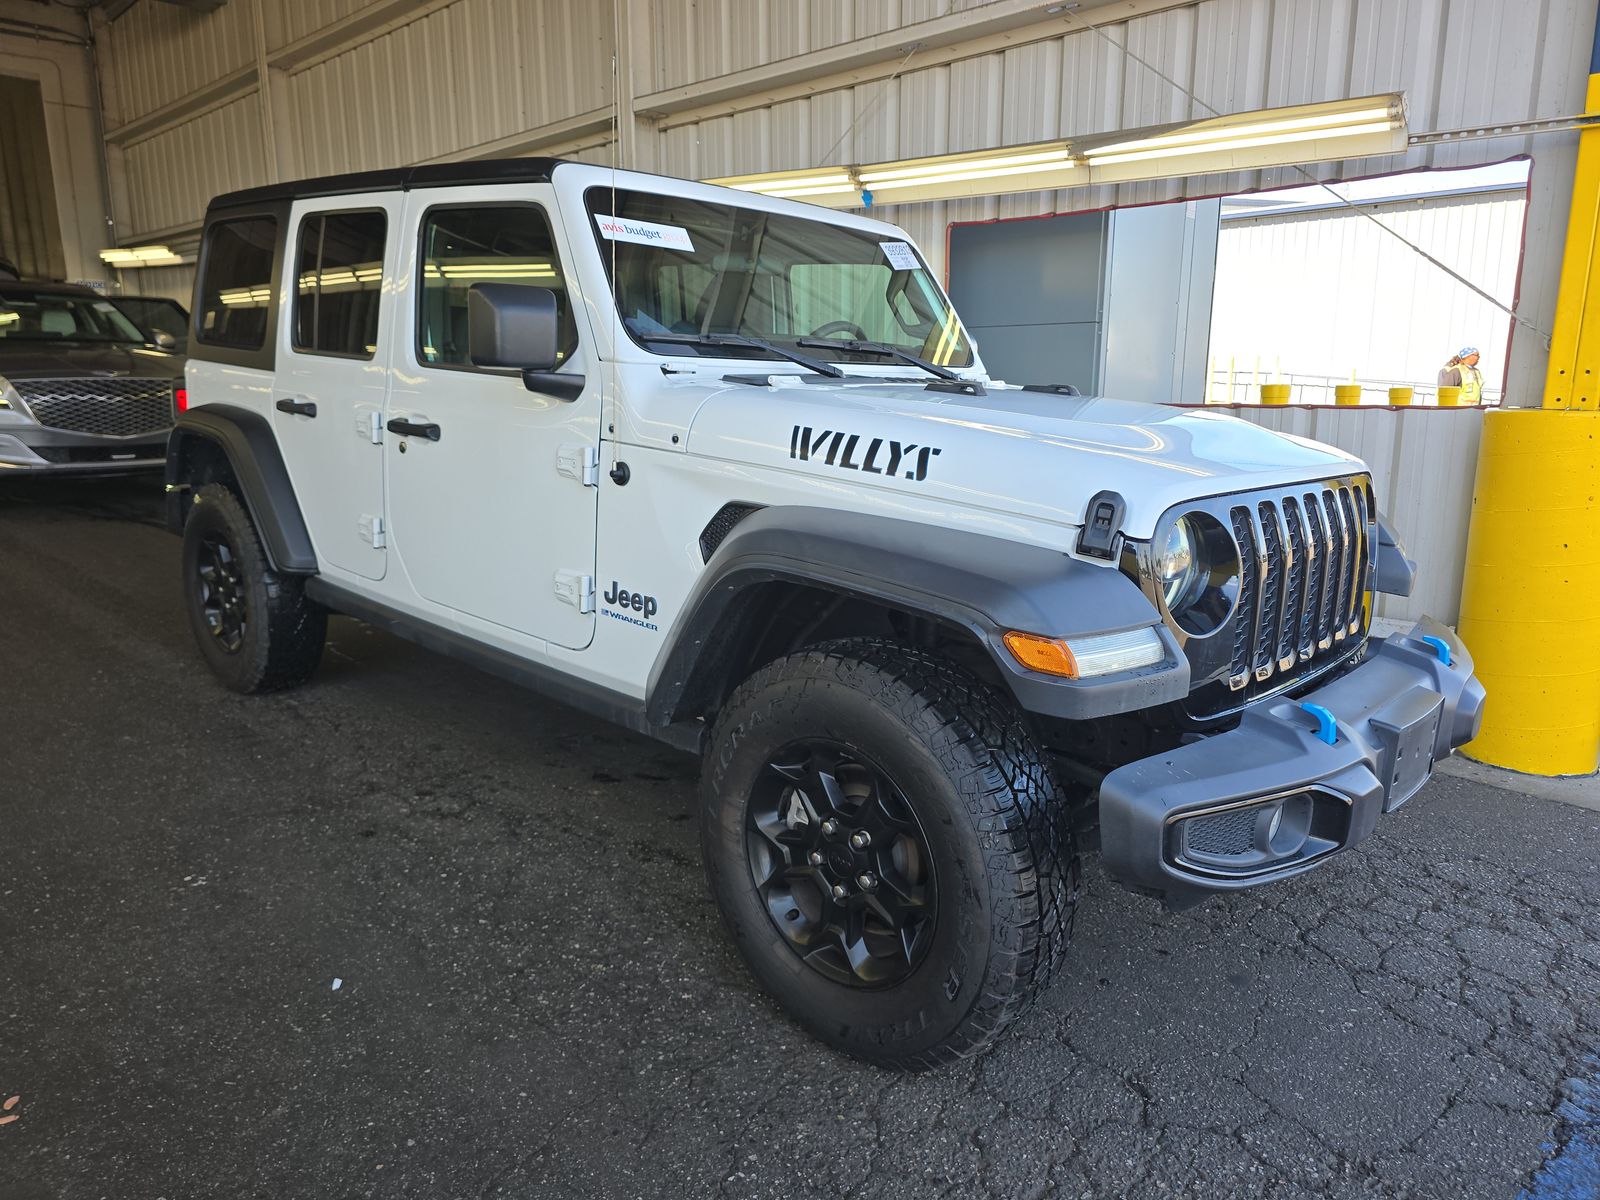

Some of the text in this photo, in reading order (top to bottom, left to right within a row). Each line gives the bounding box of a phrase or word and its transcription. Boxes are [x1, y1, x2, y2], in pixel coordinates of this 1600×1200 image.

[602, 223, 624, 234] avis
[623, 224, 663, 240] budget
[790, 425, 942, 482] WILLYS
[603, 581, 657, 619] Jeep
[609, 610, 658, 631] WRANGLER
